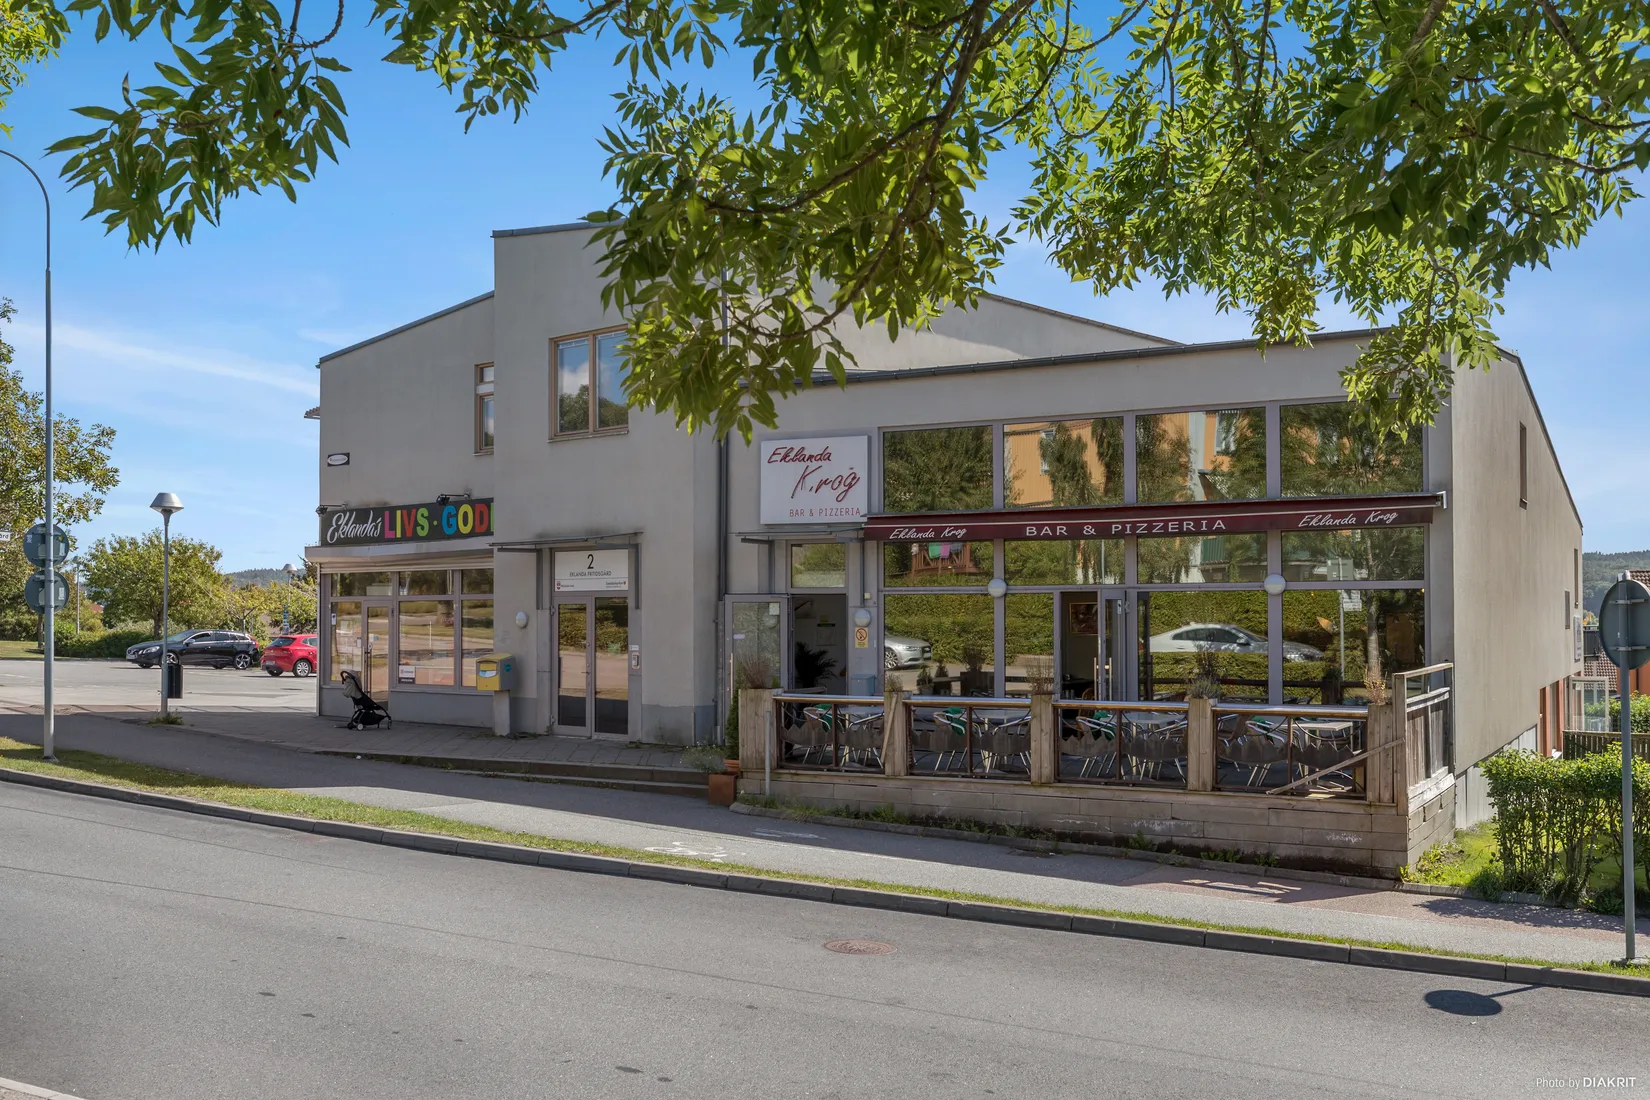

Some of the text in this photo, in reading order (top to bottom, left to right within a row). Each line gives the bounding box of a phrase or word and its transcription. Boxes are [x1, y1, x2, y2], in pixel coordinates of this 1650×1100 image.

[767, 446, 832, 463] Eklanda
[791, 465, 860, 502] Krog
[789, 507, 860, 517] BAR & PIZZERIA
[1298, 511, 1398, 527] Eklanda Krog
[327, 509, 382, 544] Eklanda's
[384, 507, 430, 539] LIVS
[889, 527, 967, 539] Eklanda Krog
[1026, 520, 1226, 536] BAR & PIZZERIA
[587, 553, 594, 569] 2
